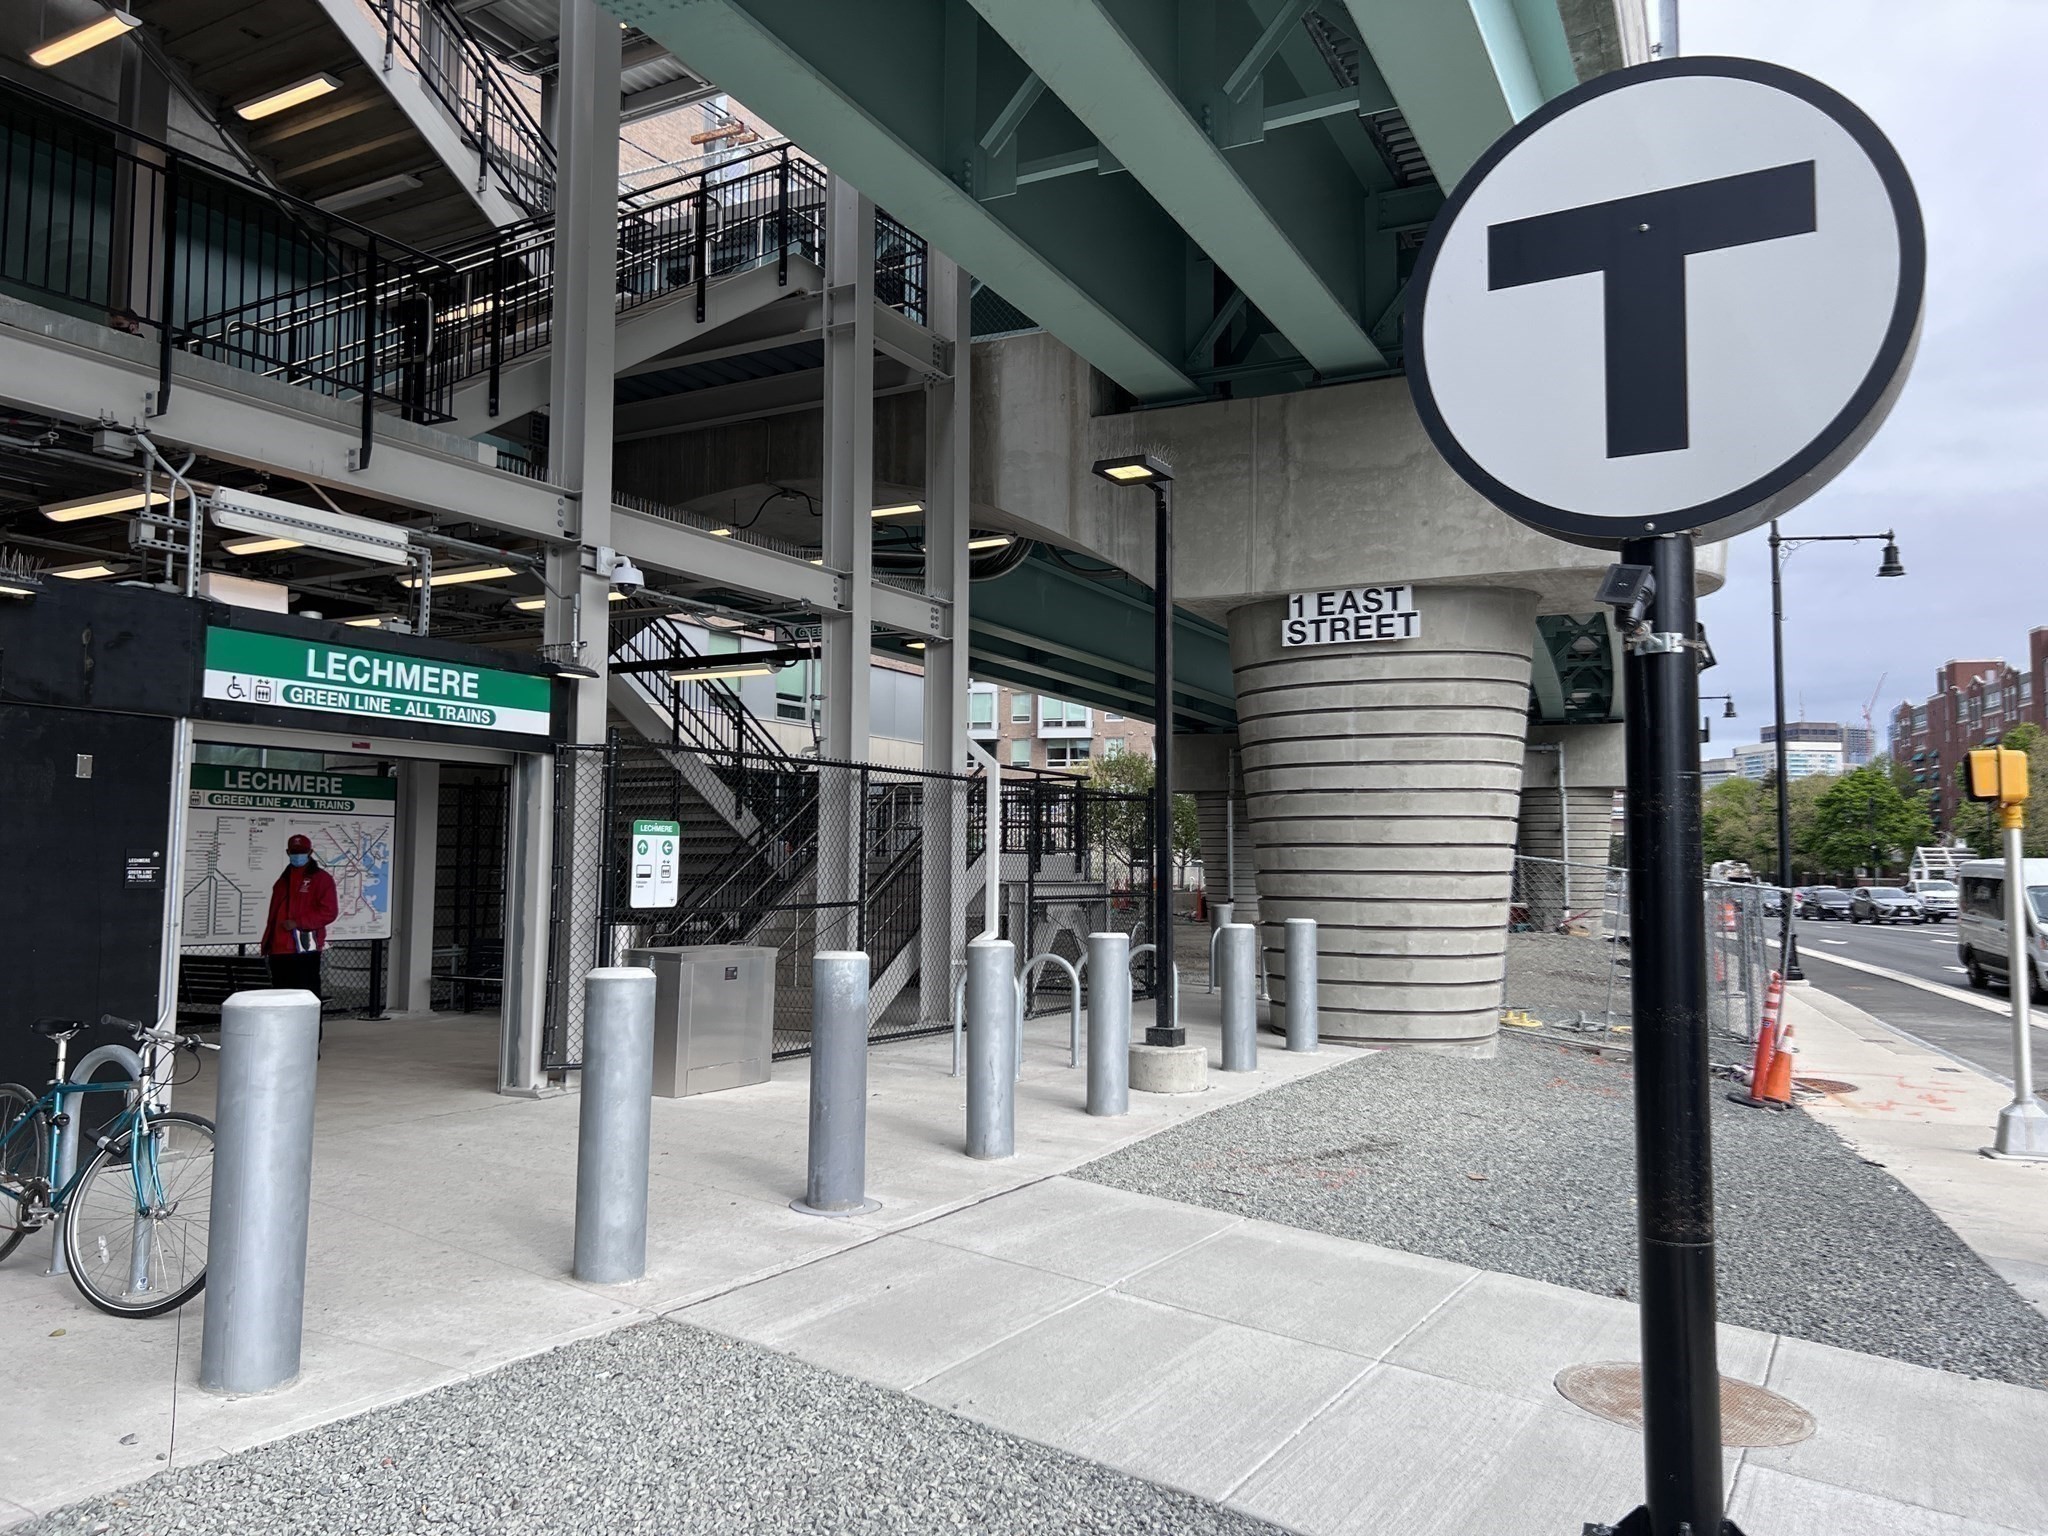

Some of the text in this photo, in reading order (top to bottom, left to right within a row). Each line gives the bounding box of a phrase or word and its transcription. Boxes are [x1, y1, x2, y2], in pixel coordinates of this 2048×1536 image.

[1487, 159, 1817, 458] T
[1292, 586, 1404, 618] 1 EAST
[798, 627, 822, 637] GREE
[1287, 612, 1418, 645] STREET
[307, 648, 479, 699] LECHMERE
[290, 686, 350, 708] GREEN
[355, 695, 391, 713] LINE
[405, 701, 434, 718] ALL
[437, 705, 491, 724] TRAINS
[224, 770, 342, 794] LECHMERE
[213, 794, 253, 806] GREEN
[256, 796, 281, 807] LINE
[290, 798, 311, 808] ALL
[313, 799, 351, 811] TRAINS
[640, 825, 673, 833] LECHMERE
